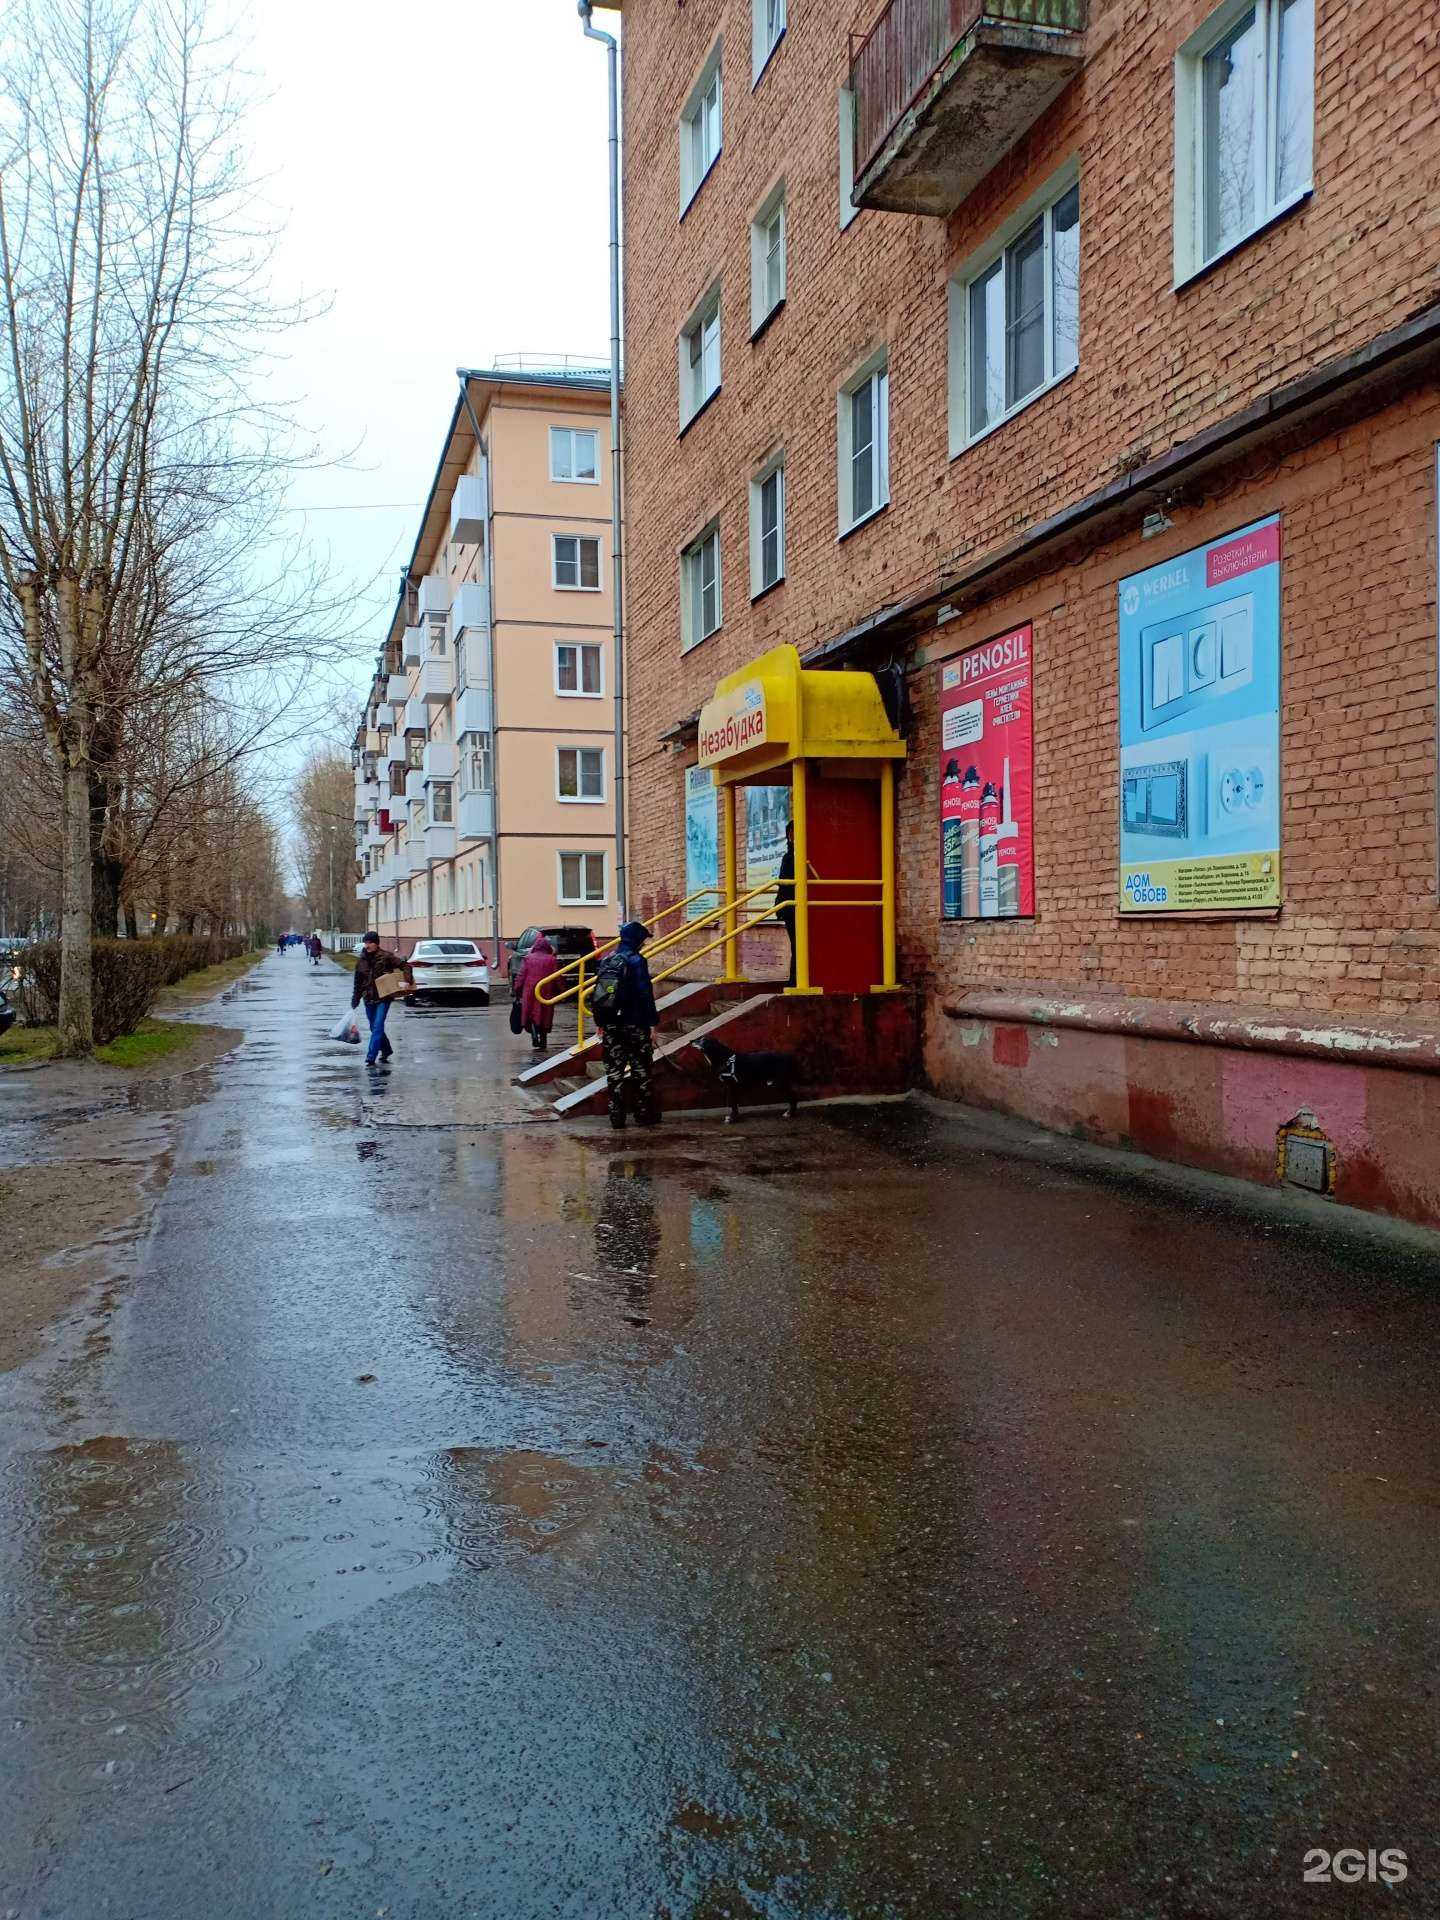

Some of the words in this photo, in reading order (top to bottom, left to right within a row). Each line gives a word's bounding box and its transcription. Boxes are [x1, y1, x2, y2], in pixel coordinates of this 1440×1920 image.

[1213, 544, 1246, 568] Розетки
[1213, 548, 1268, 578] выключатели
[1143, 567, 1189, 594] WERKEL
[962, 634, 1028, 682] PENOSIL
[701, 710, 763, 758] Незабудка
[1125, 873, 1151, 891] ДОМ
[1133, 887, 1167, 903] ОБОЕВ
